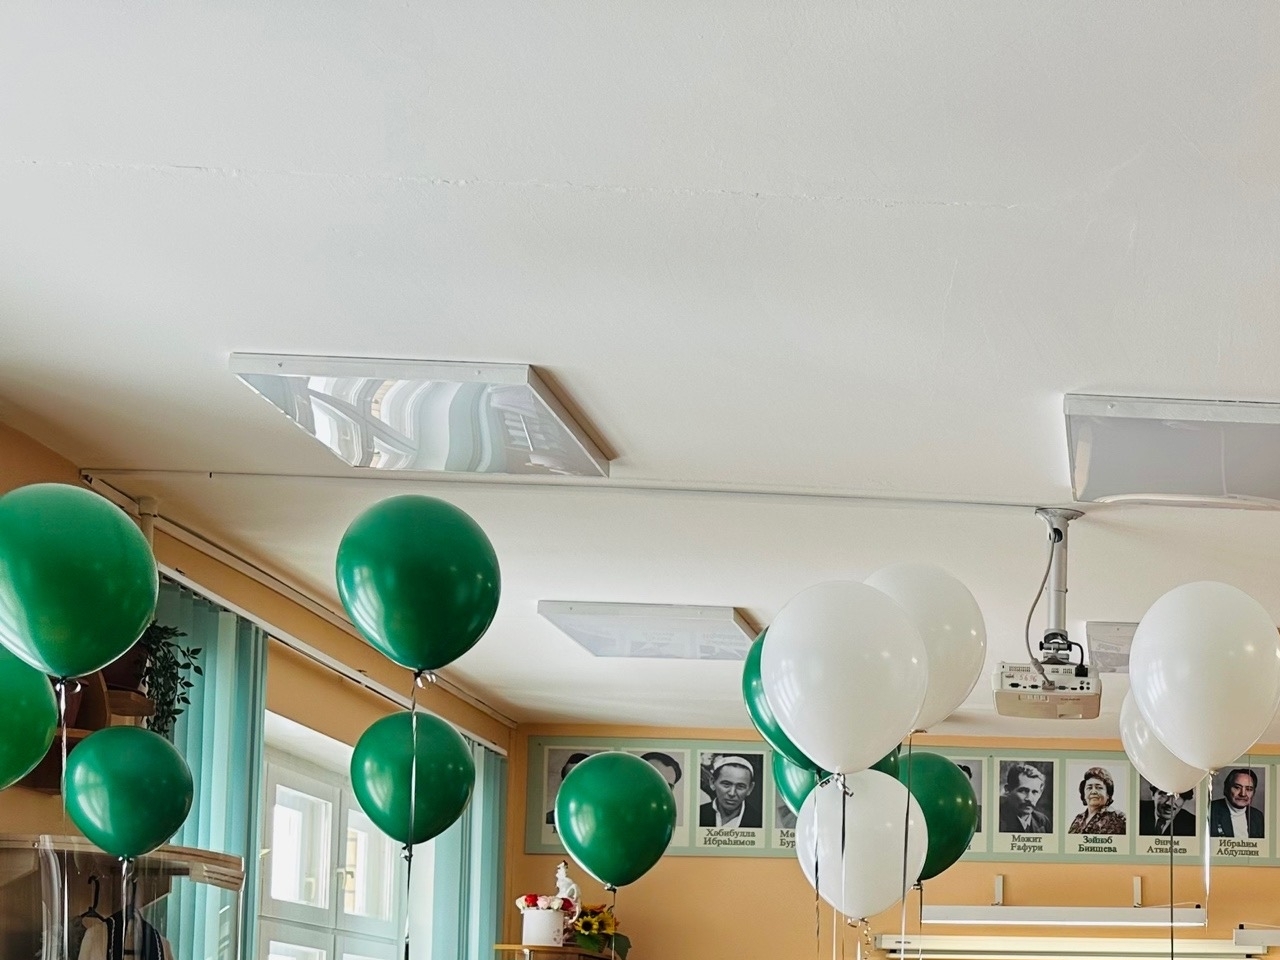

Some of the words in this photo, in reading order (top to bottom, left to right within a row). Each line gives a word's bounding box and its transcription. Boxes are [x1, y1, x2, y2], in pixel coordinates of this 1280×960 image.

[703, 837, 756, 847] Ибраһимов
[1218, 839, 1257, 848] Ибраһим
[1078, 844, 1118, 853] Биишева
[1216, 848, 1259, 857] Абдуллин
